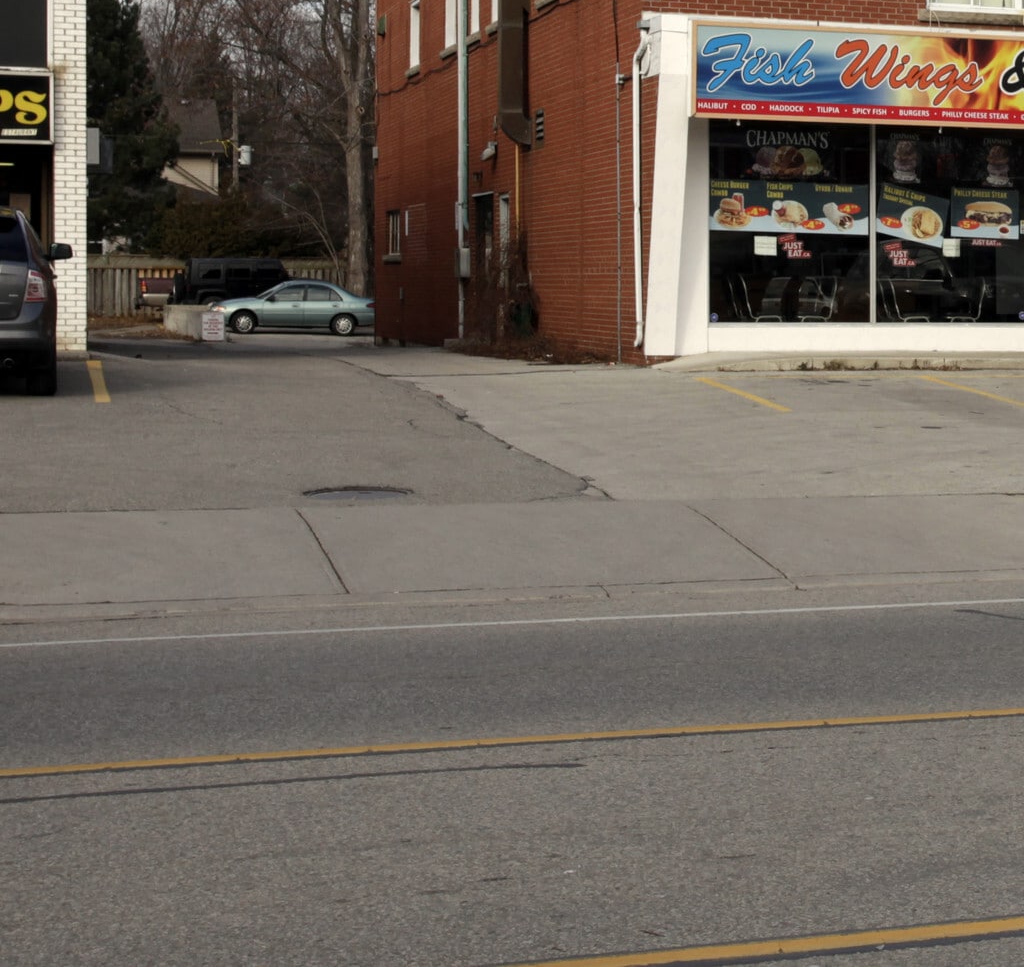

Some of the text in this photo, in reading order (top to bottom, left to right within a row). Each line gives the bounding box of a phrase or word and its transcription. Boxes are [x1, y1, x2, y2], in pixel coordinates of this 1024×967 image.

[702, 32, 816, 94] Fish
[835, 38, 984, 107] Wings
[697, 101, 728, 110] HALIBUT
[741, 103, 757, 111] COD
[769, 104, 804, 113] HADDOCK
[816, 106, 840, 114] TILIPIA
[852, 107, 887, 116] SPICY FISH
[899, 109, 930, 117] BURGERS
[942, 110, 1009, 120] PHILLY CHEESE STEAK
[746, 129, 829, 149] CHAPMAN'S
[783, 242, 803, 250] JUST
[889, 251, 909, 259] JUST
